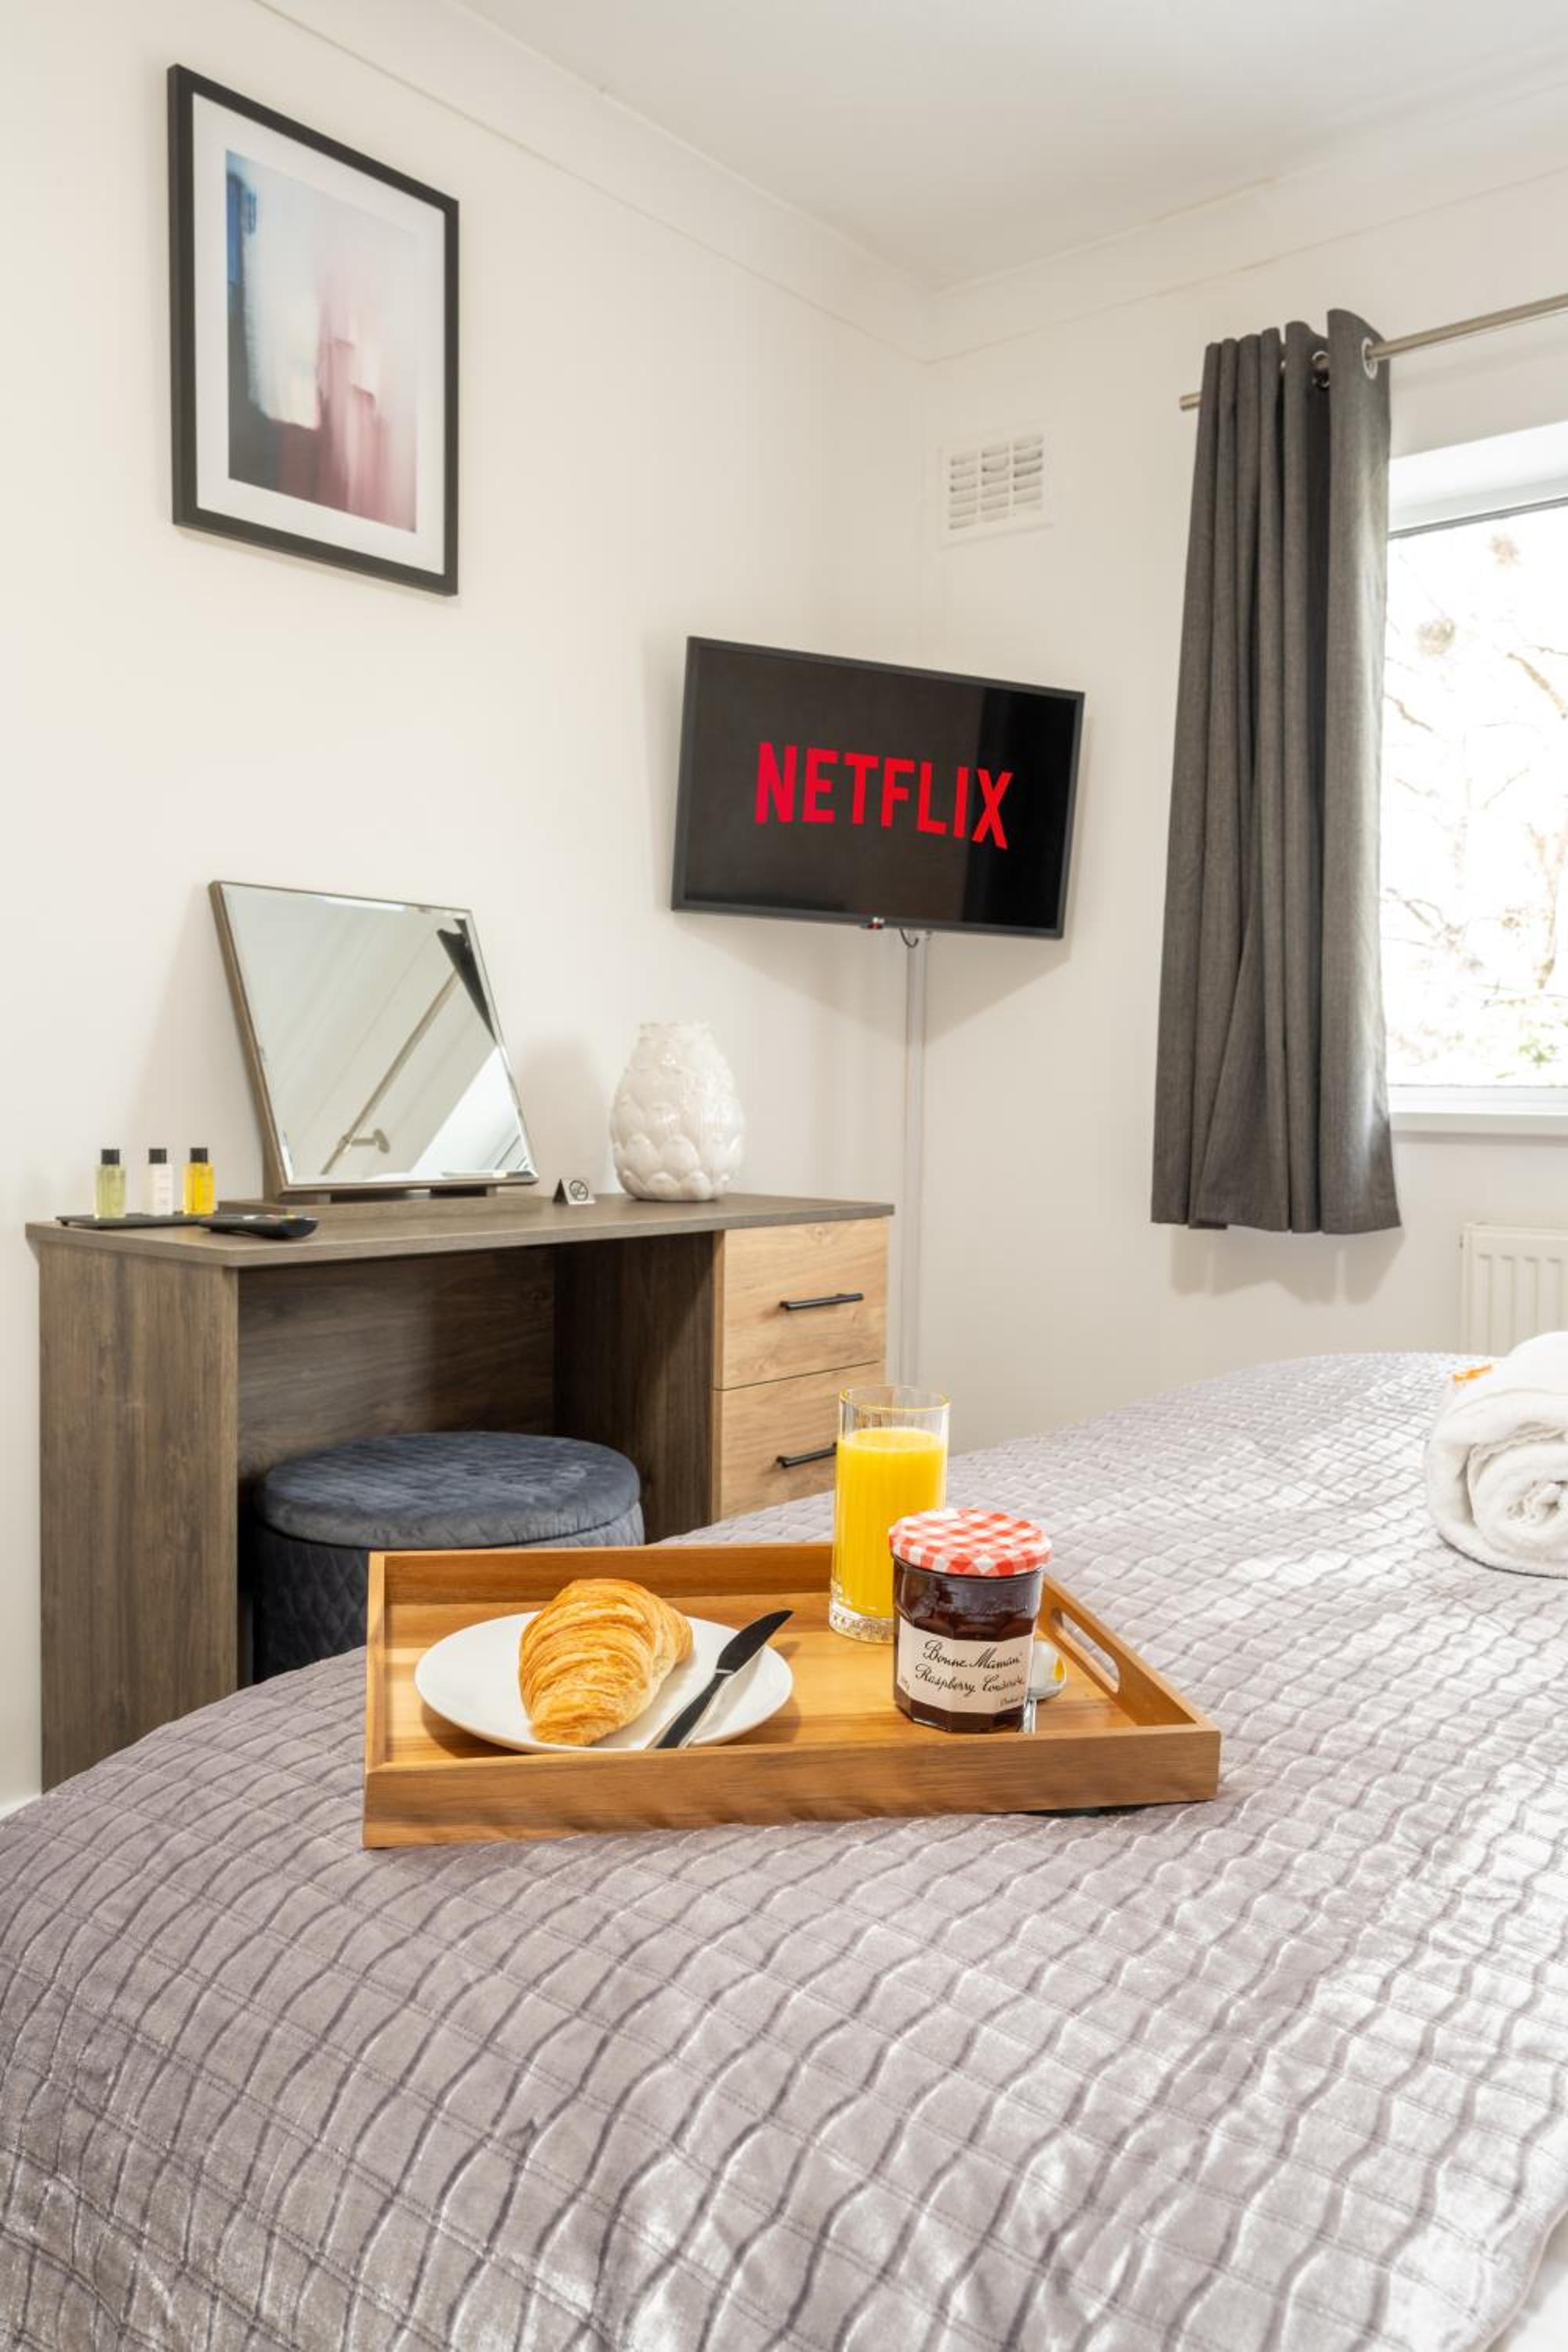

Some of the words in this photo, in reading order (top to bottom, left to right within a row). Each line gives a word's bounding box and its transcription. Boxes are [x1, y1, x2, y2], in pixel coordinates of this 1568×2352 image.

[754, 740, 1014, 850] NETFLIX
[922, 1639, 968, 1668] Bonne
[969, 1646, 1019, 1669] Maman
[915, 1663, 976, 1698] Raspberry
